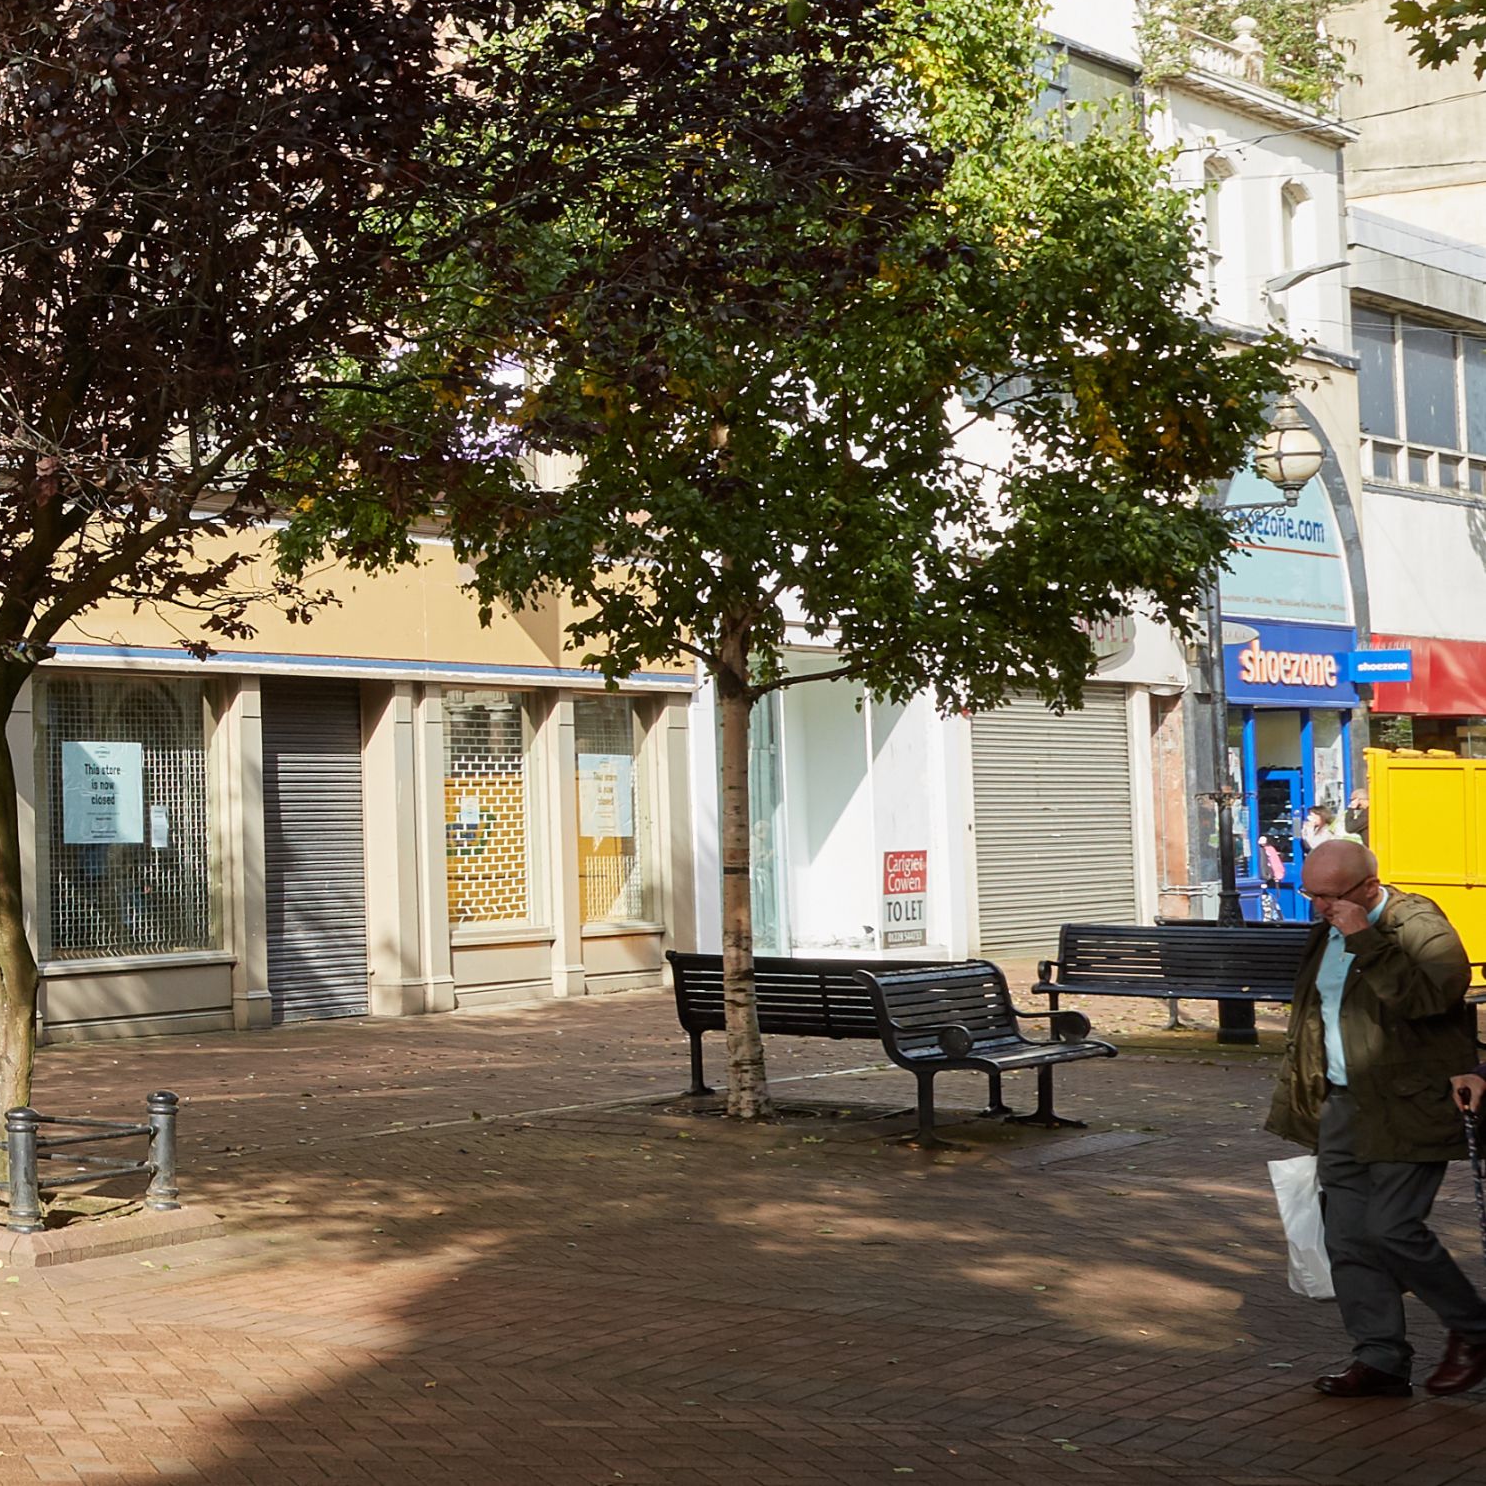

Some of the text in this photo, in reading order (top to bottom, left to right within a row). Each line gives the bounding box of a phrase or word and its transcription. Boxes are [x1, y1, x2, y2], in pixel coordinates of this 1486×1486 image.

[1240, 639, 1338, 687] shoezone
[1357, 661, 1408, 672] shoezone
[84, 763, 121, 775] This store
[91, 780, 115, 790] is now
[91, 795, 115, 805] closed
[887, 854, 923, 877] Carigiet
[888, 873, 921, 892] Cowen
[887, 900, 923, 922] TO LET
